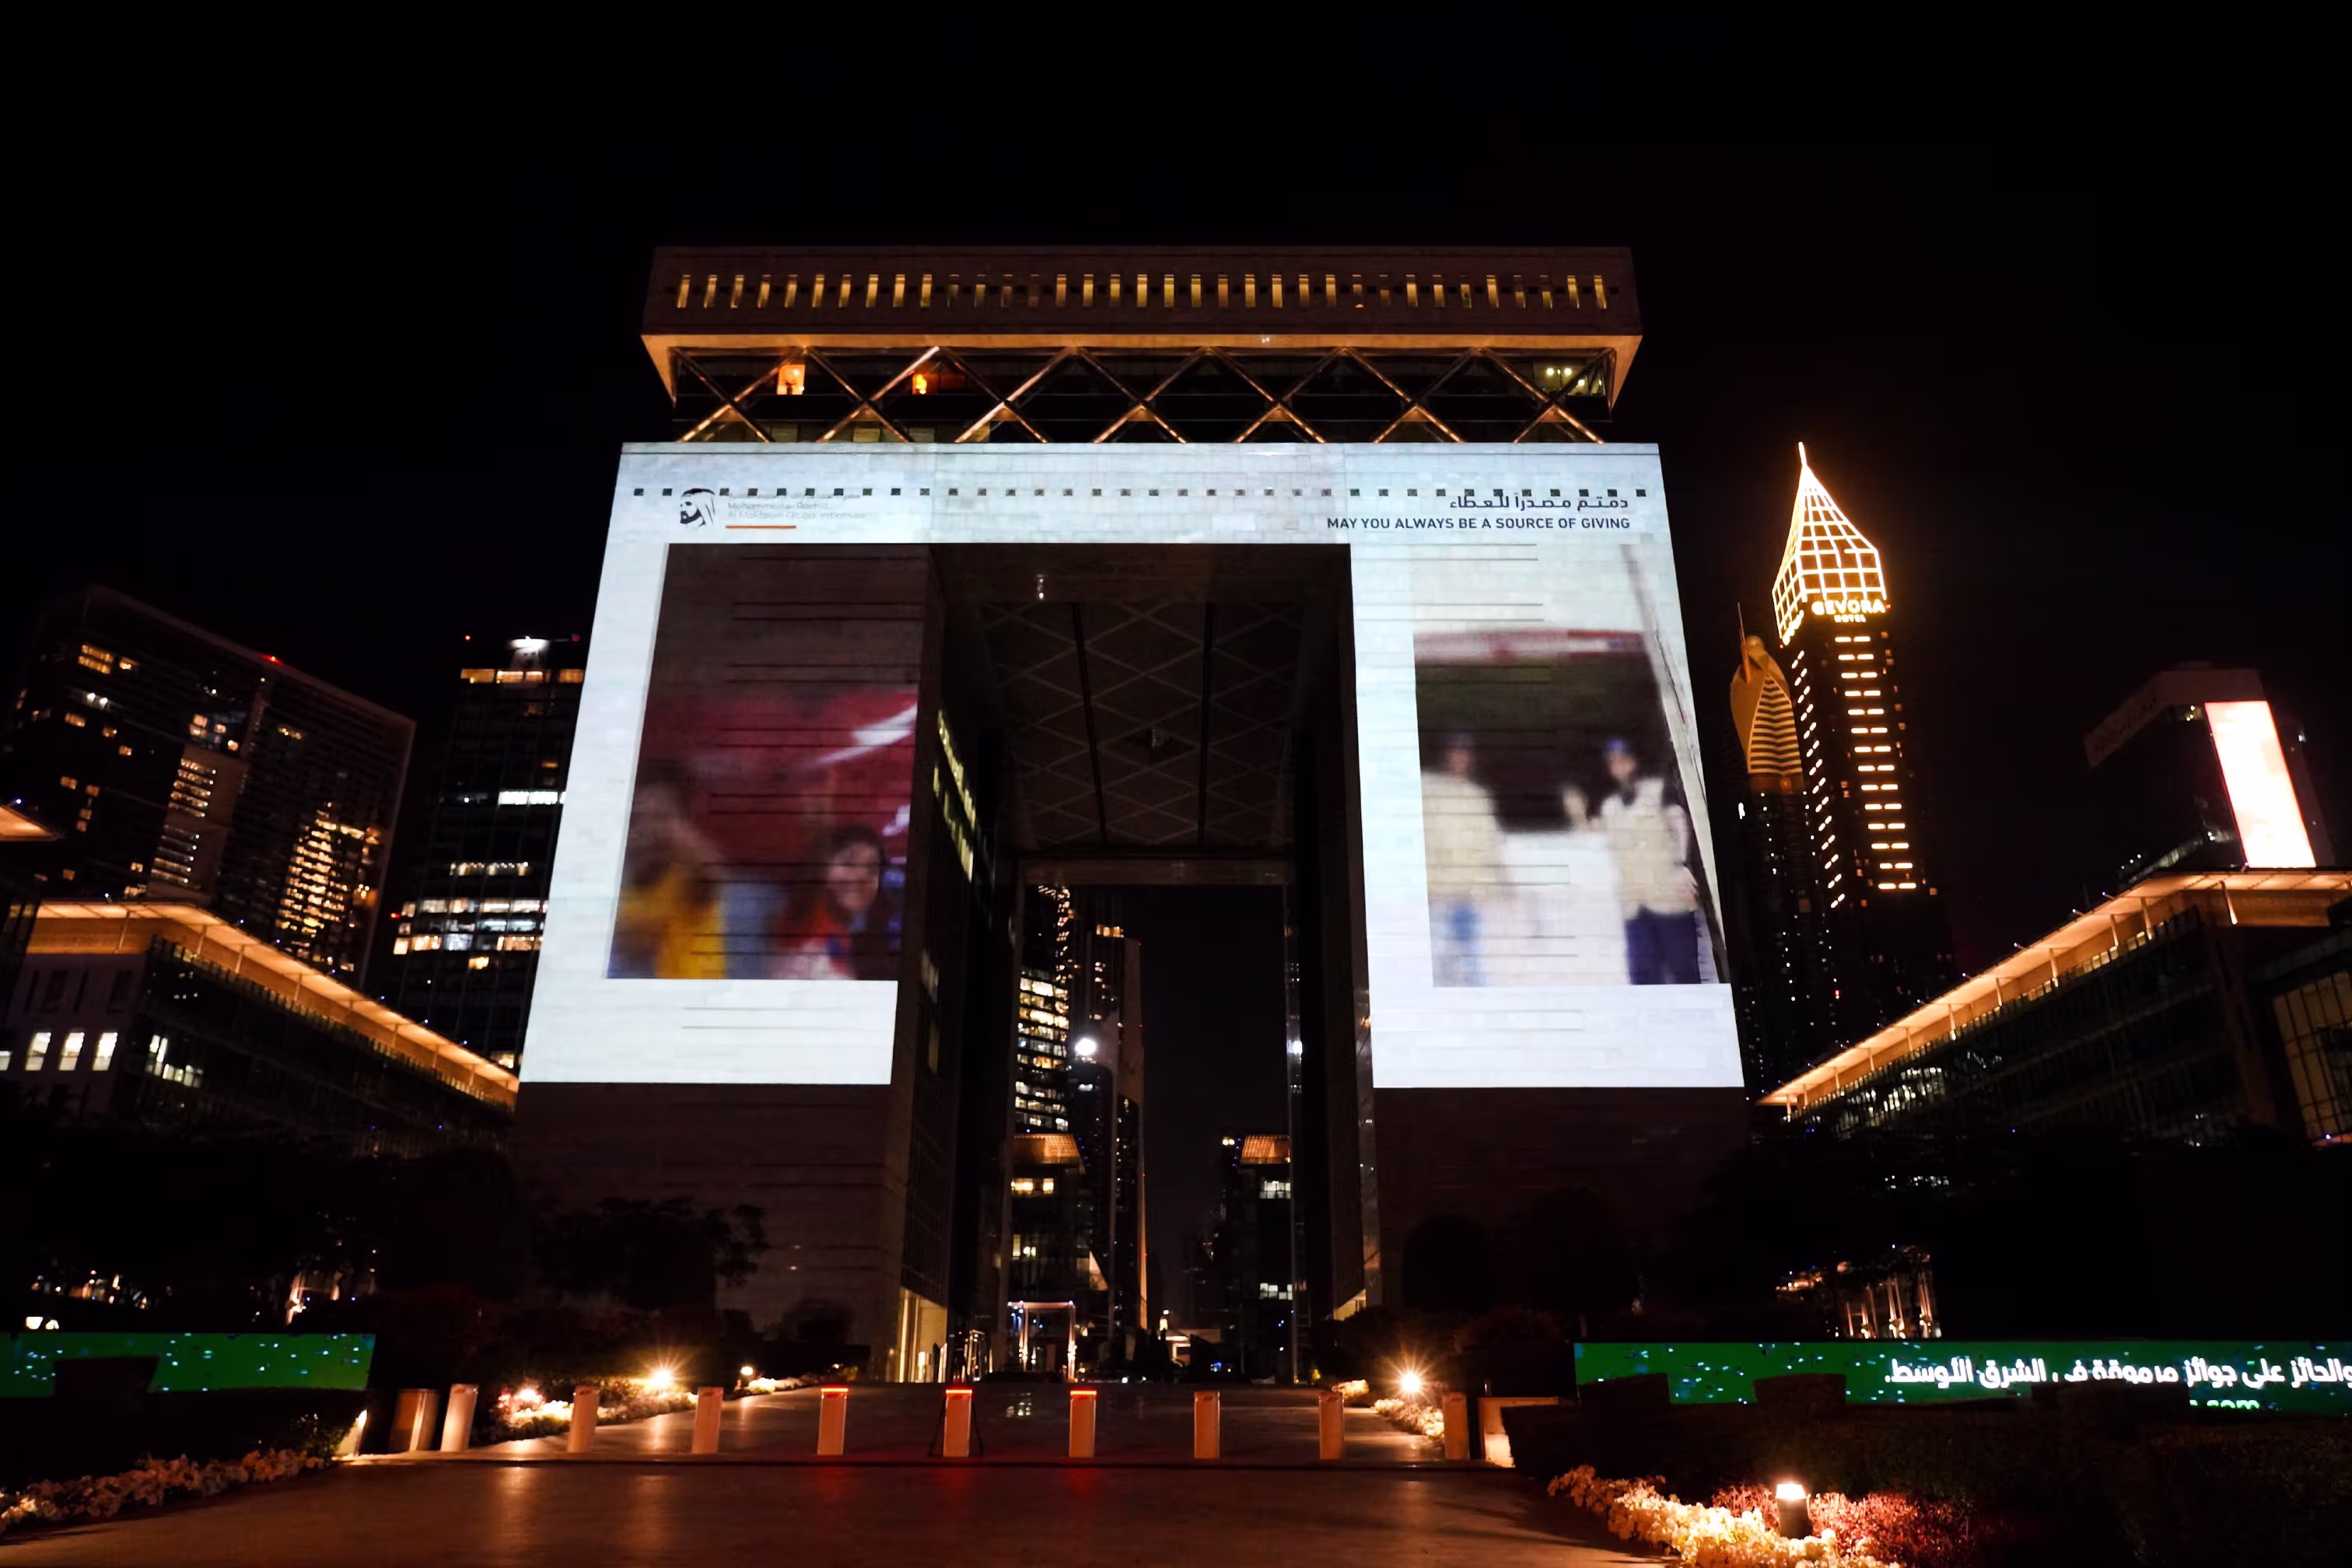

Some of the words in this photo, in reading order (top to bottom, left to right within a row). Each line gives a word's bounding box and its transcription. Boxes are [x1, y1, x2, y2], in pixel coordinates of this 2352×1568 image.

[1450, 495, 1510, 509] للعطاء
[1327, 518, 1357, 529] MAY
[1361, 518, 1390, 529] YOU
[1395, 518, 1454, 529] ALWAYS
[1458, 518, 1477, 529] BE
[1481, 518, 1492, 529] A
[1496, 518, 1554, 529] SOURCE
[1558, 518, 1577, 529] OF
[1581, 518, 1630, 529] GIVING
[1979, 1358, 2047, 1389] الشرق
[2184, 1356, 2241, 1388] جوائز
[2242, 1358, 2285, 1388] على
